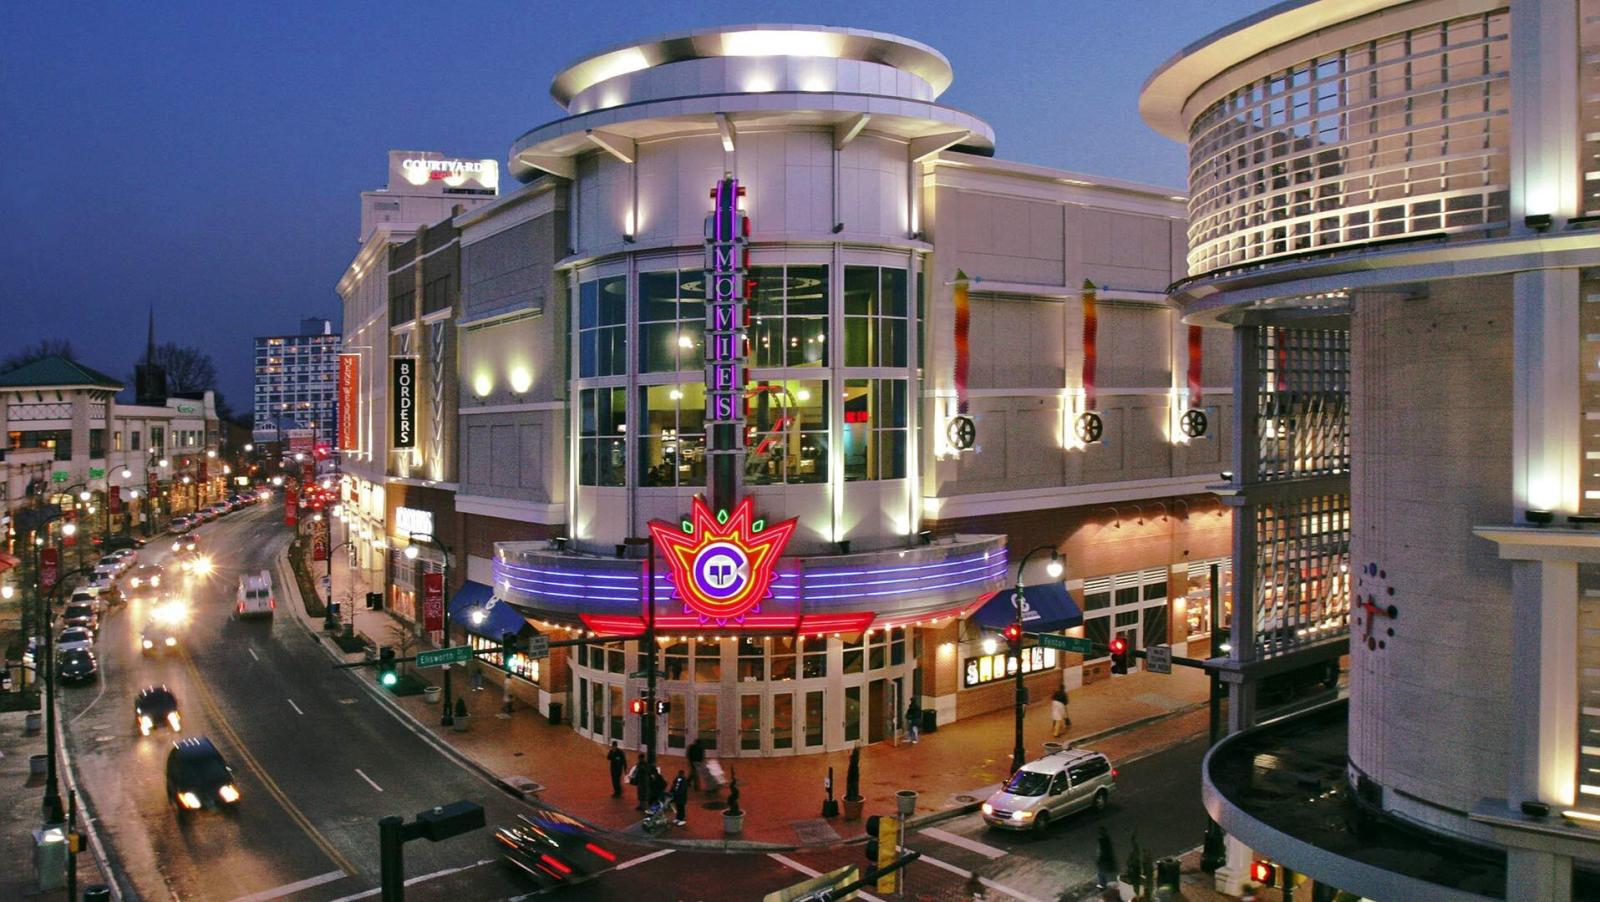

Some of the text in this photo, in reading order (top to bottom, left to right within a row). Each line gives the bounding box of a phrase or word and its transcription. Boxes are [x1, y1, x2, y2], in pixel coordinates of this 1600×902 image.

[402, 159, 483, 172] COURTYARD
[715, 246, 734, 417] MOVIES
[399, 363, 411, 443] BORDERS
